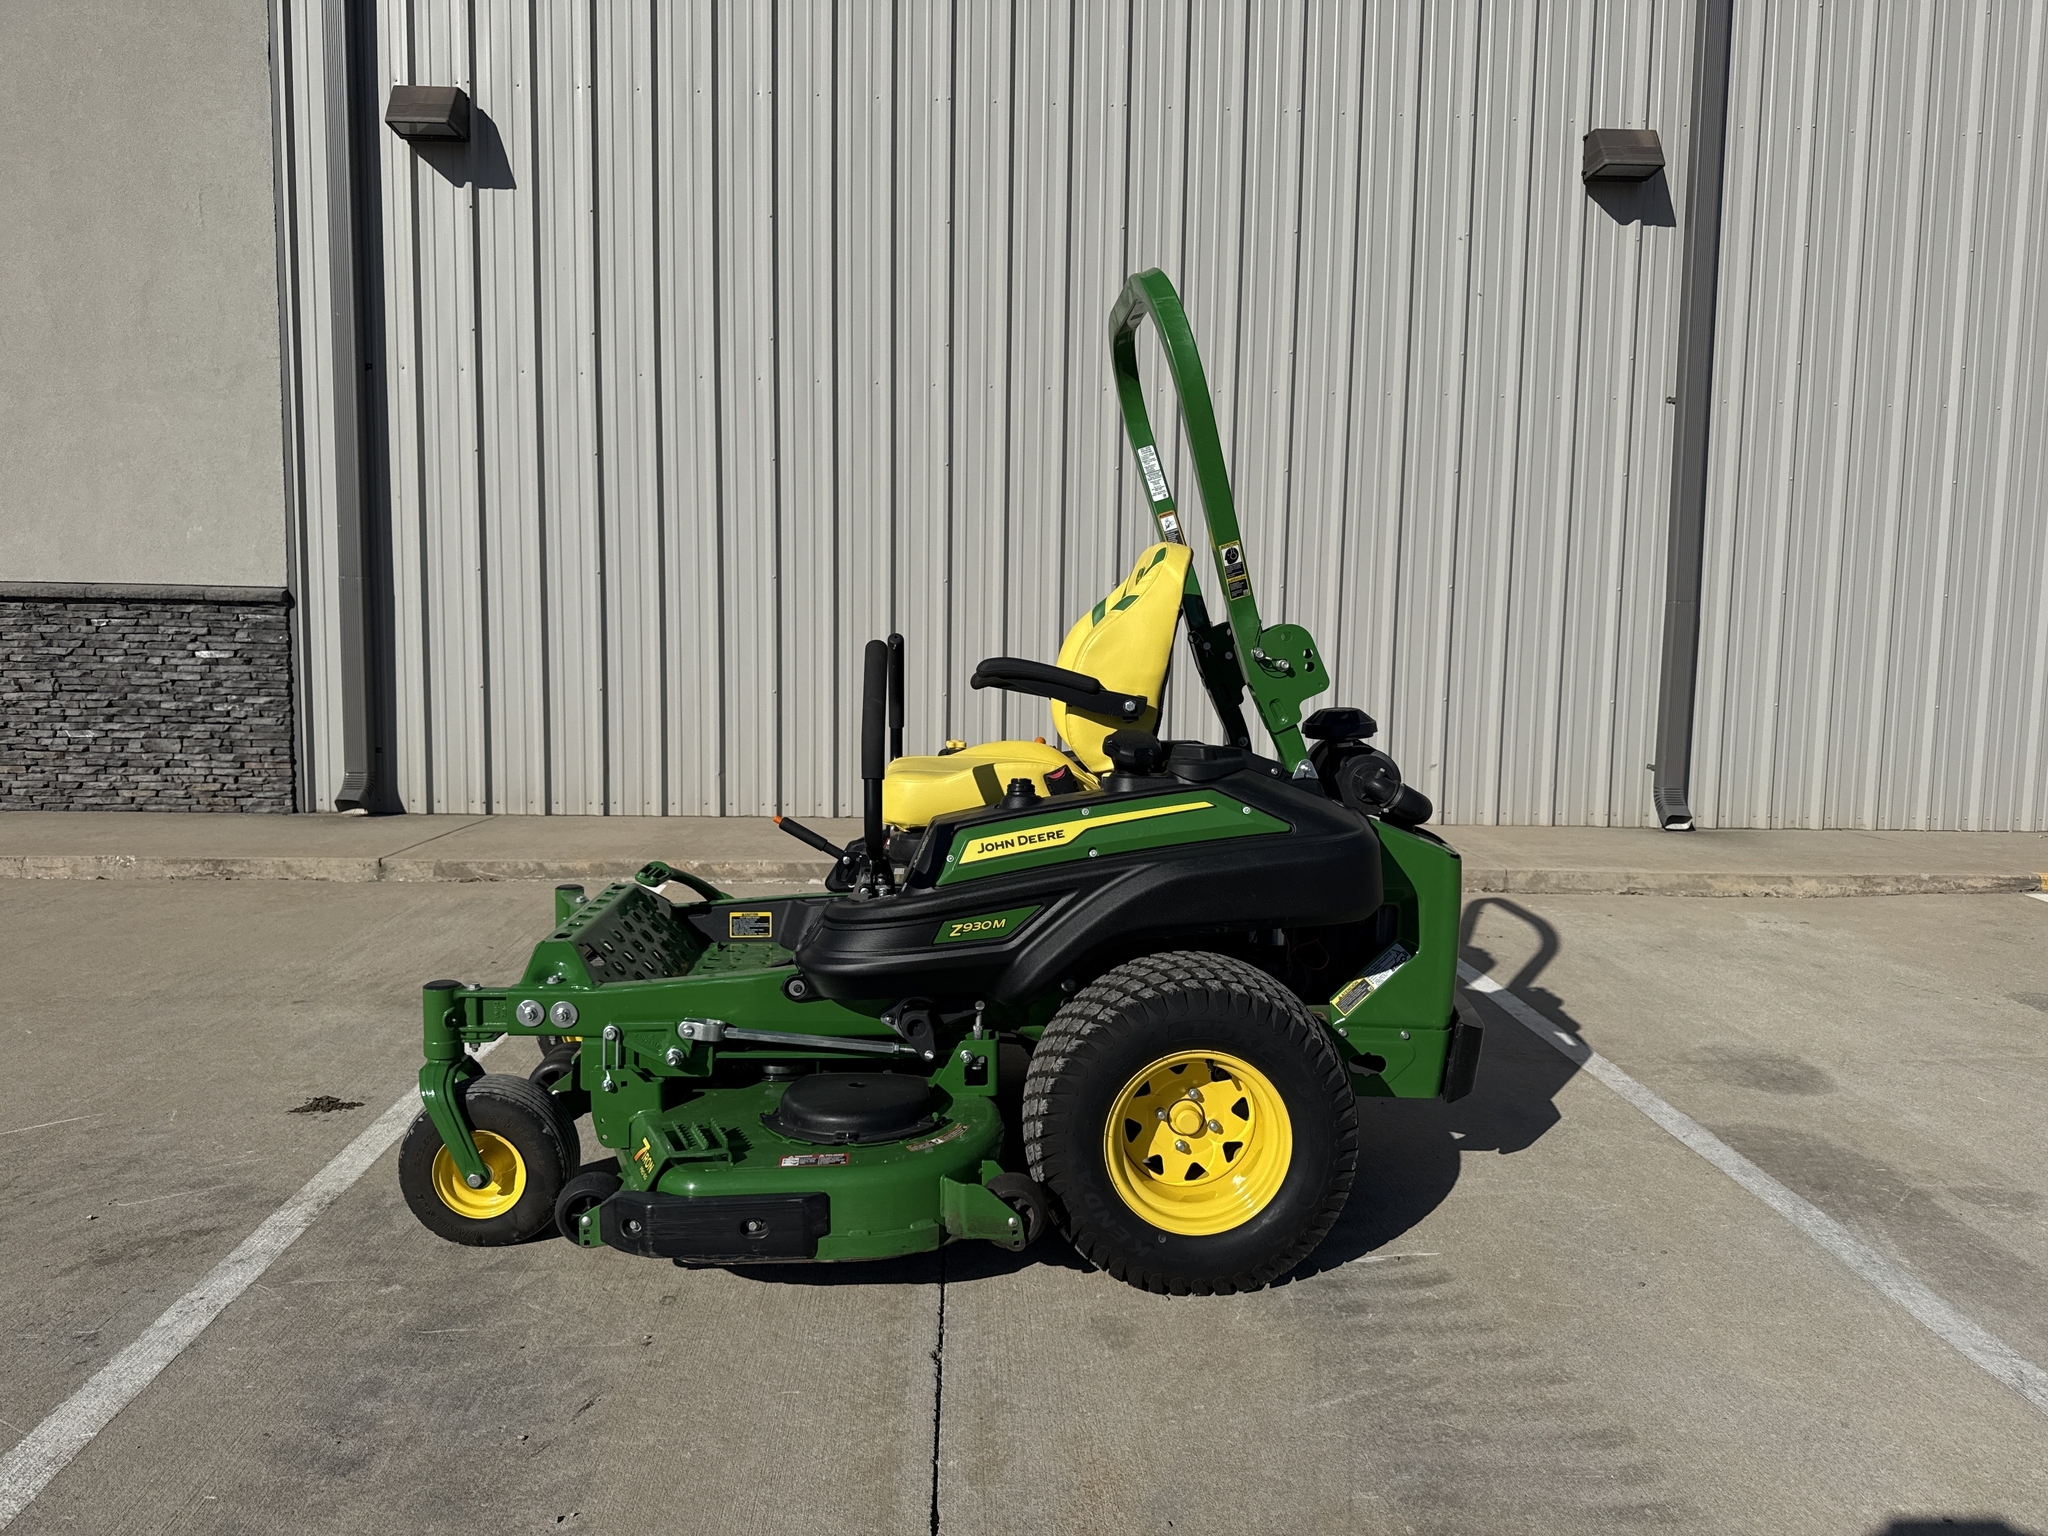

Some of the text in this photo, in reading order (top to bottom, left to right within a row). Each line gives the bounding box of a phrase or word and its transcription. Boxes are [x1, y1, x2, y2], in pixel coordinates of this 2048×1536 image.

[977, 829, 1065, 854] JOHN DEERE
[634, 1137, 655, 1174] 7 IRON
[1076, 1168, 1155, 1258] KENDA
